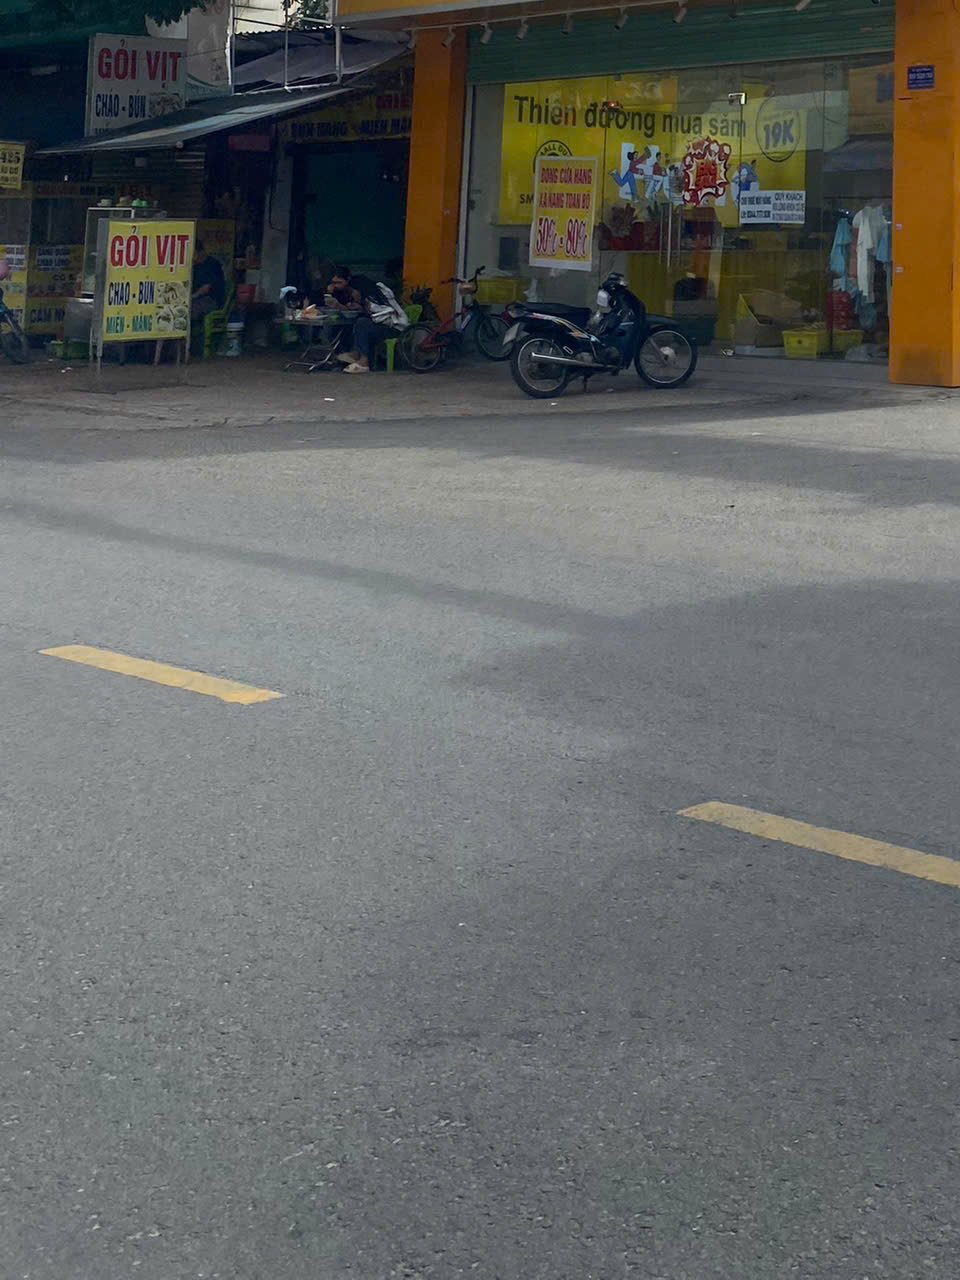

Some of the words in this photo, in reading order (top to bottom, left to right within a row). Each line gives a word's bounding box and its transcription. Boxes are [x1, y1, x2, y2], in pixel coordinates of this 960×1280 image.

[97, 39, 137, 80] GỎI
[146, 49, 182, 88] VỊT
[96, 88, 120, 118] CHÁO
[128, 89, 146, 118] BÚN
[662, 111, 703, 134] mua
[762, 118, 794, 146] 19K
[110, 225, 148, 267] GỎI
[156, 234, 189, 272] VỊT
[108, 275, 130, 305] CHÁO
[138, 275, 155, 304] BÚN
